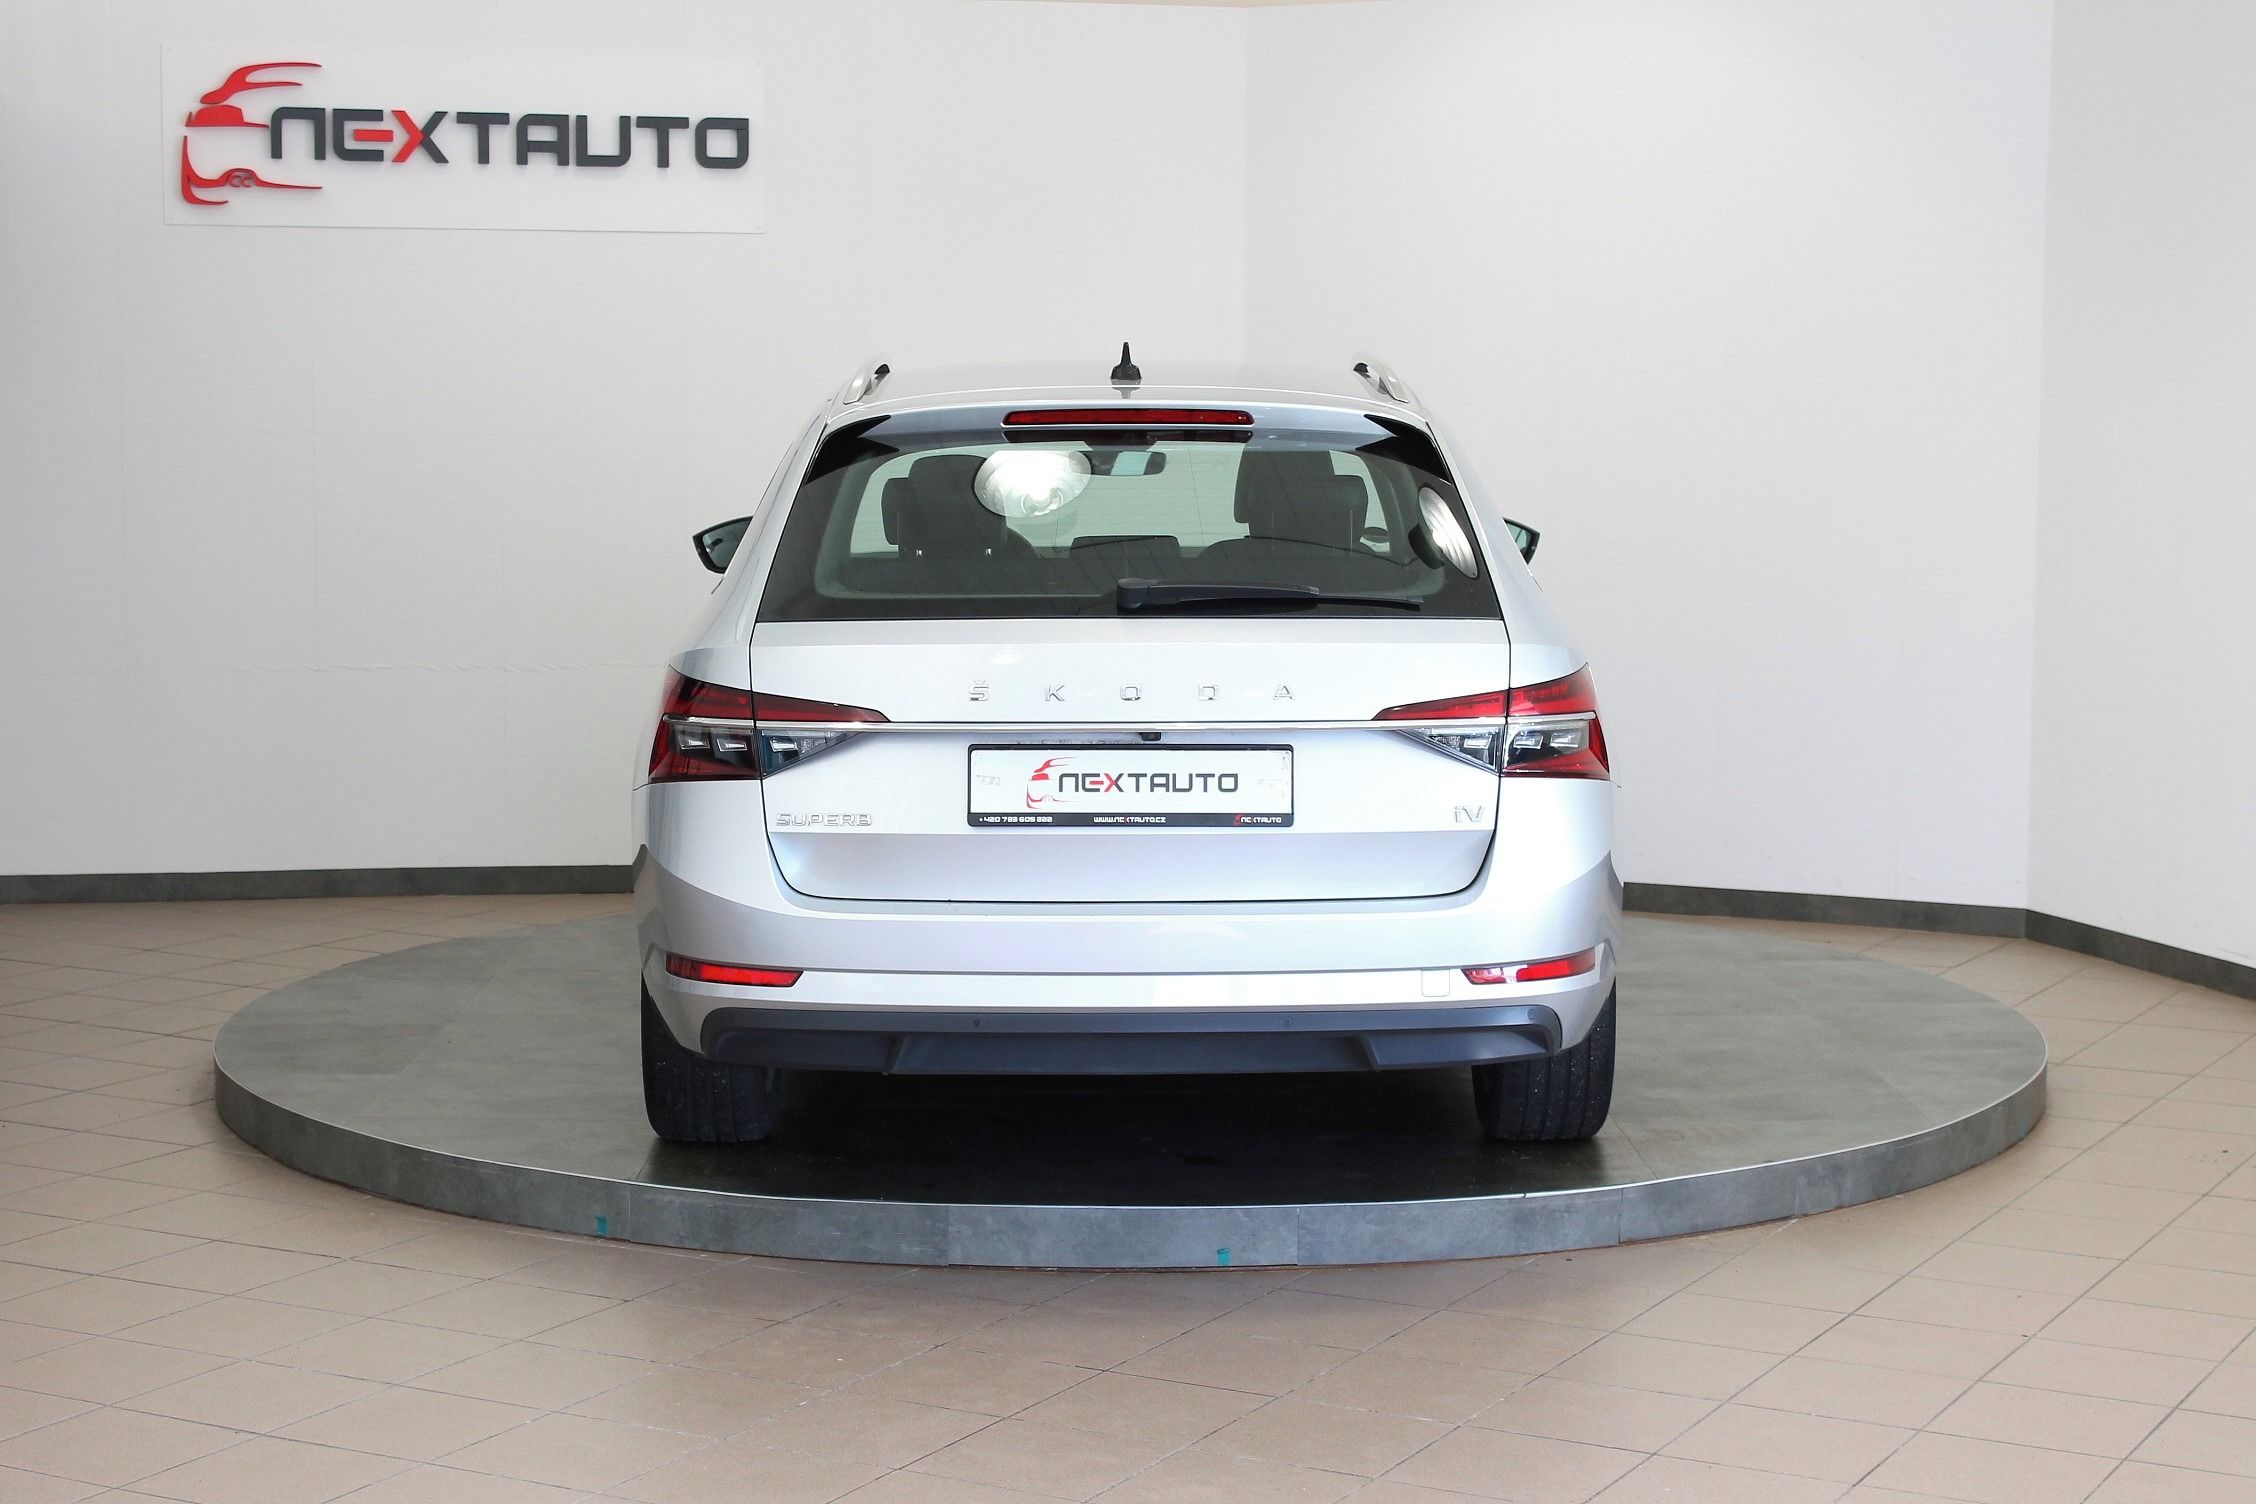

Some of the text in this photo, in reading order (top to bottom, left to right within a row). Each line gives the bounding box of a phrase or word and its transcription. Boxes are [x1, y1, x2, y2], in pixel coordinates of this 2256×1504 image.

[270, 106, 750, 169] NEXTAUTO
[1058, 773, 1238, 792] NEXTAUTO
[776, 813, 871, 826] SUPERB
